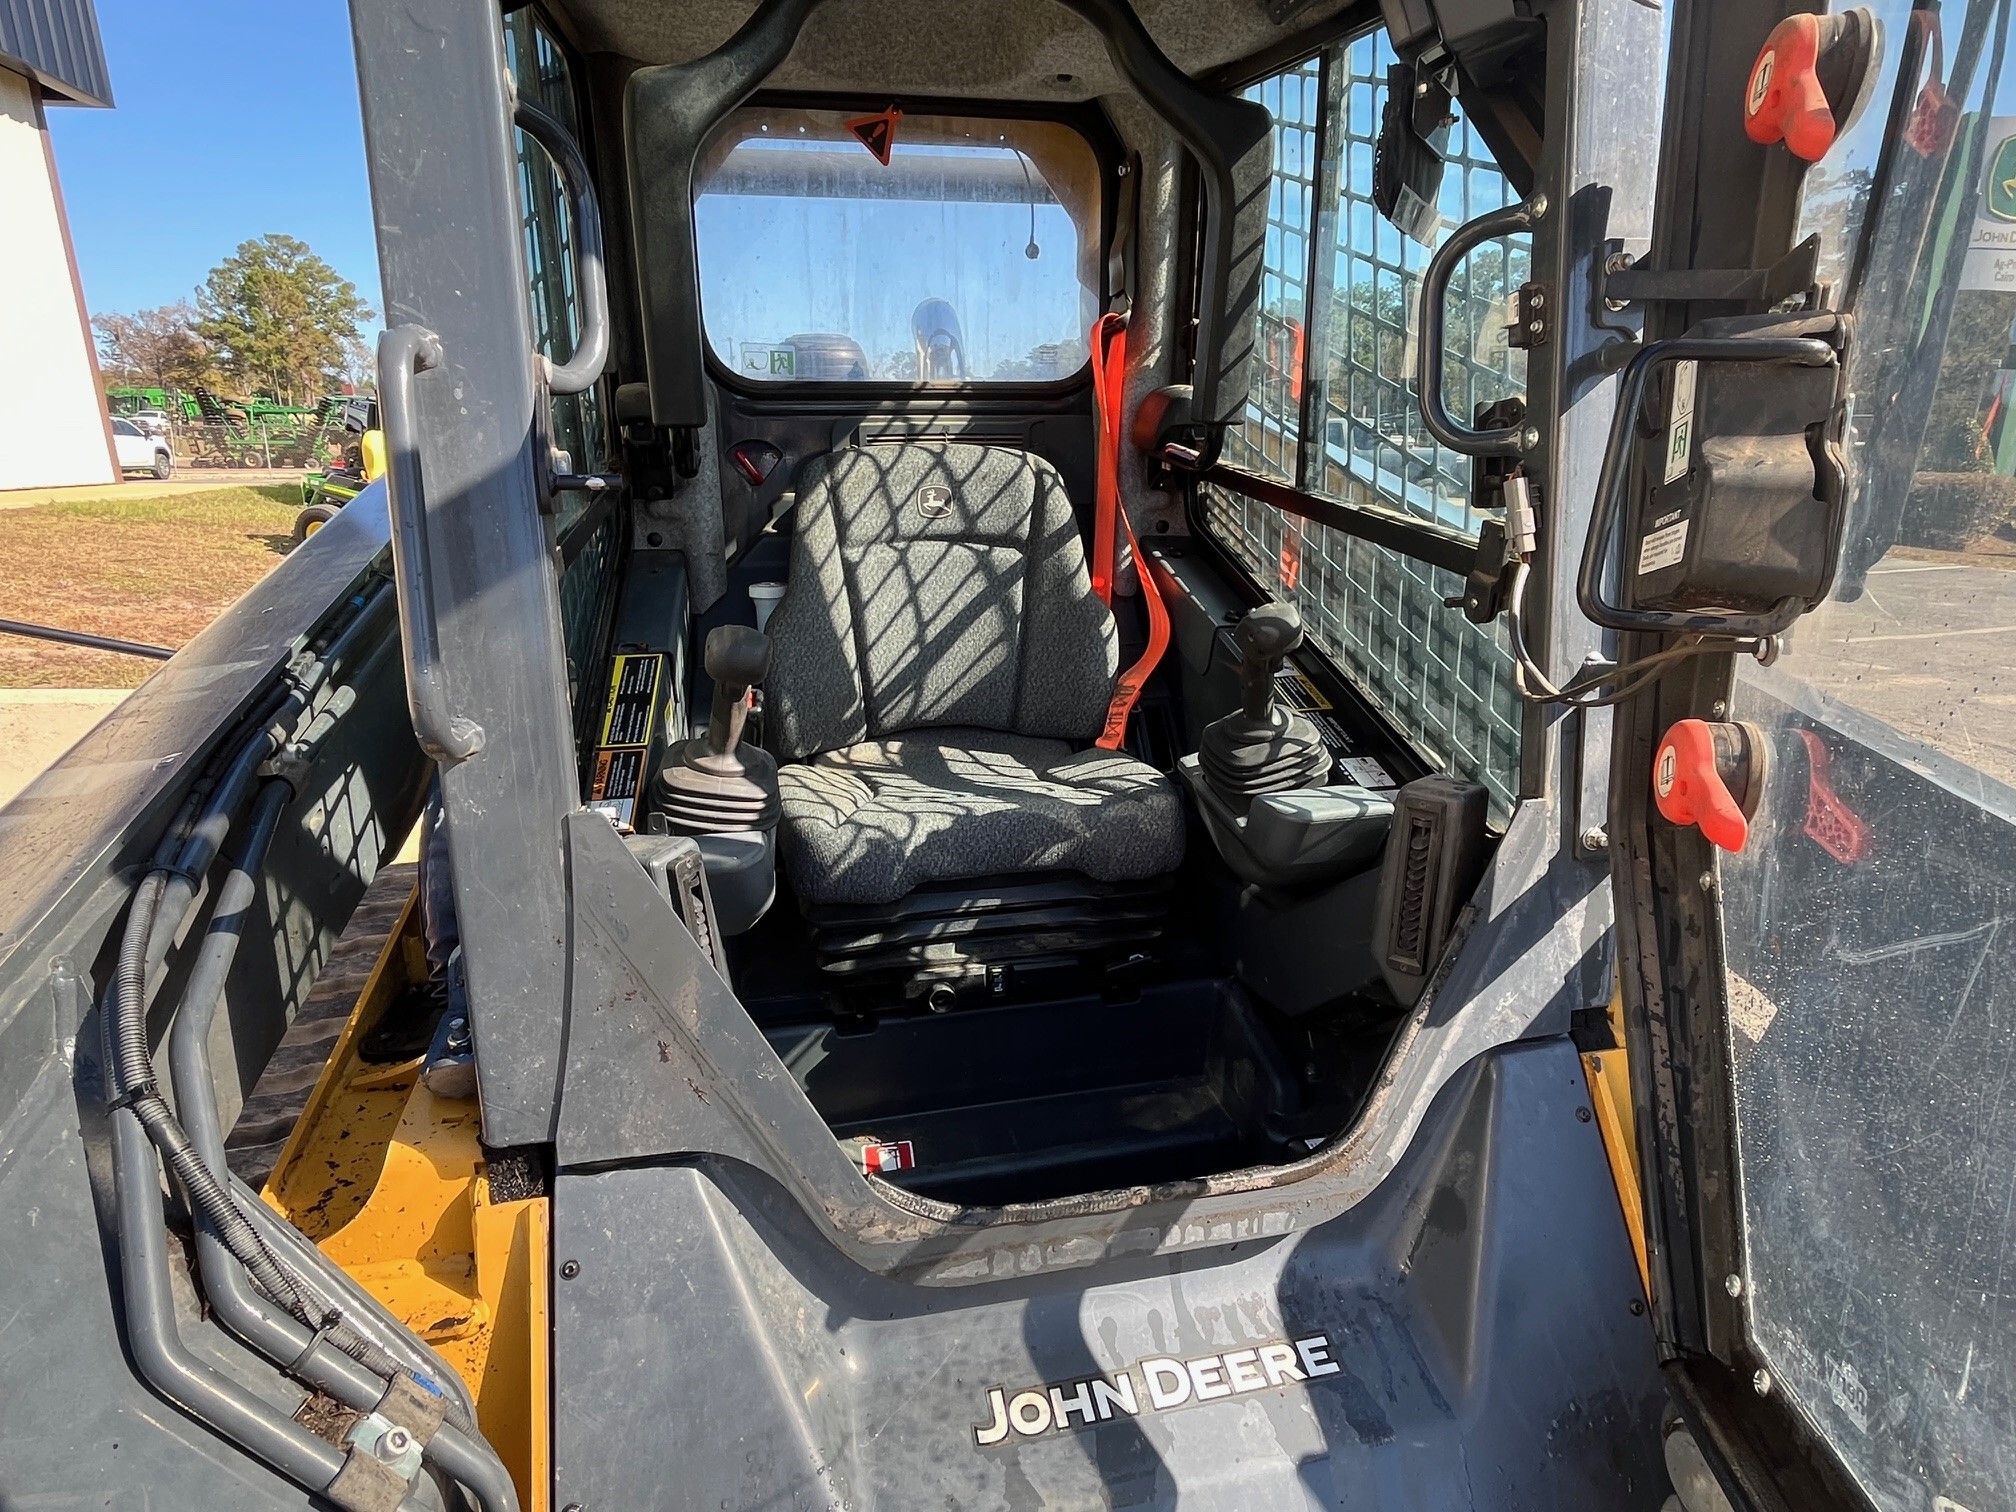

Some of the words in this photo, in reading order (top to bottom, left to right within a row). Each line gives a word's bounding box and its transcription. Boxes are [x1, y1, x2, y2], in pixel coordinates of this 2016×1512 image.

[1972, 229, 2009, 242] JOHN
[976, 1372, 1139, 1444] JOHN
[1141, 1336, 1340, 1411] DEERE
